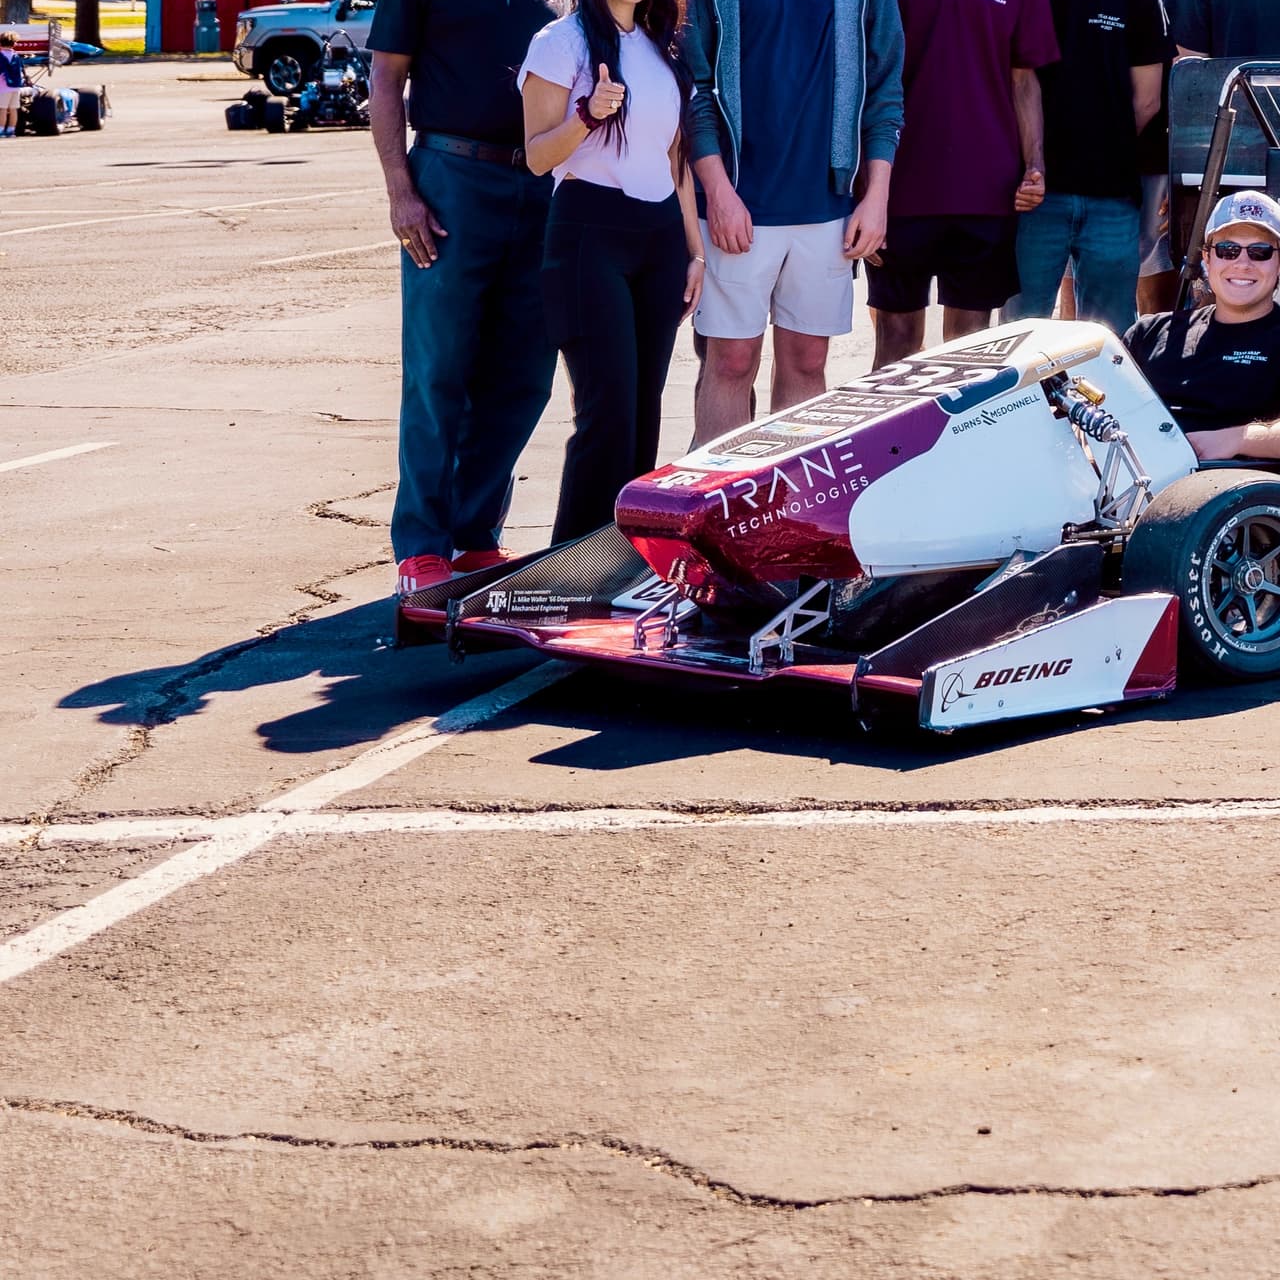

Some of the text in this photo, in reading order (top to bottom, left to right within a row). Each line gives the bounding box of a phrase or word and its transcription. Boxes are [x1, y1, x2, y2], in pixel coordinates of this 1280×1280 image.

[951, 418, 982, 435] BURNS
[704, 438, 864, 520] TRANE
[727, 475, 870, 538] TECHNOLOGIES
[540, 605, 569, 613] Engineering
[556, 595, 585, 605] Department
[973, 658, 1073, 690] BOEING
